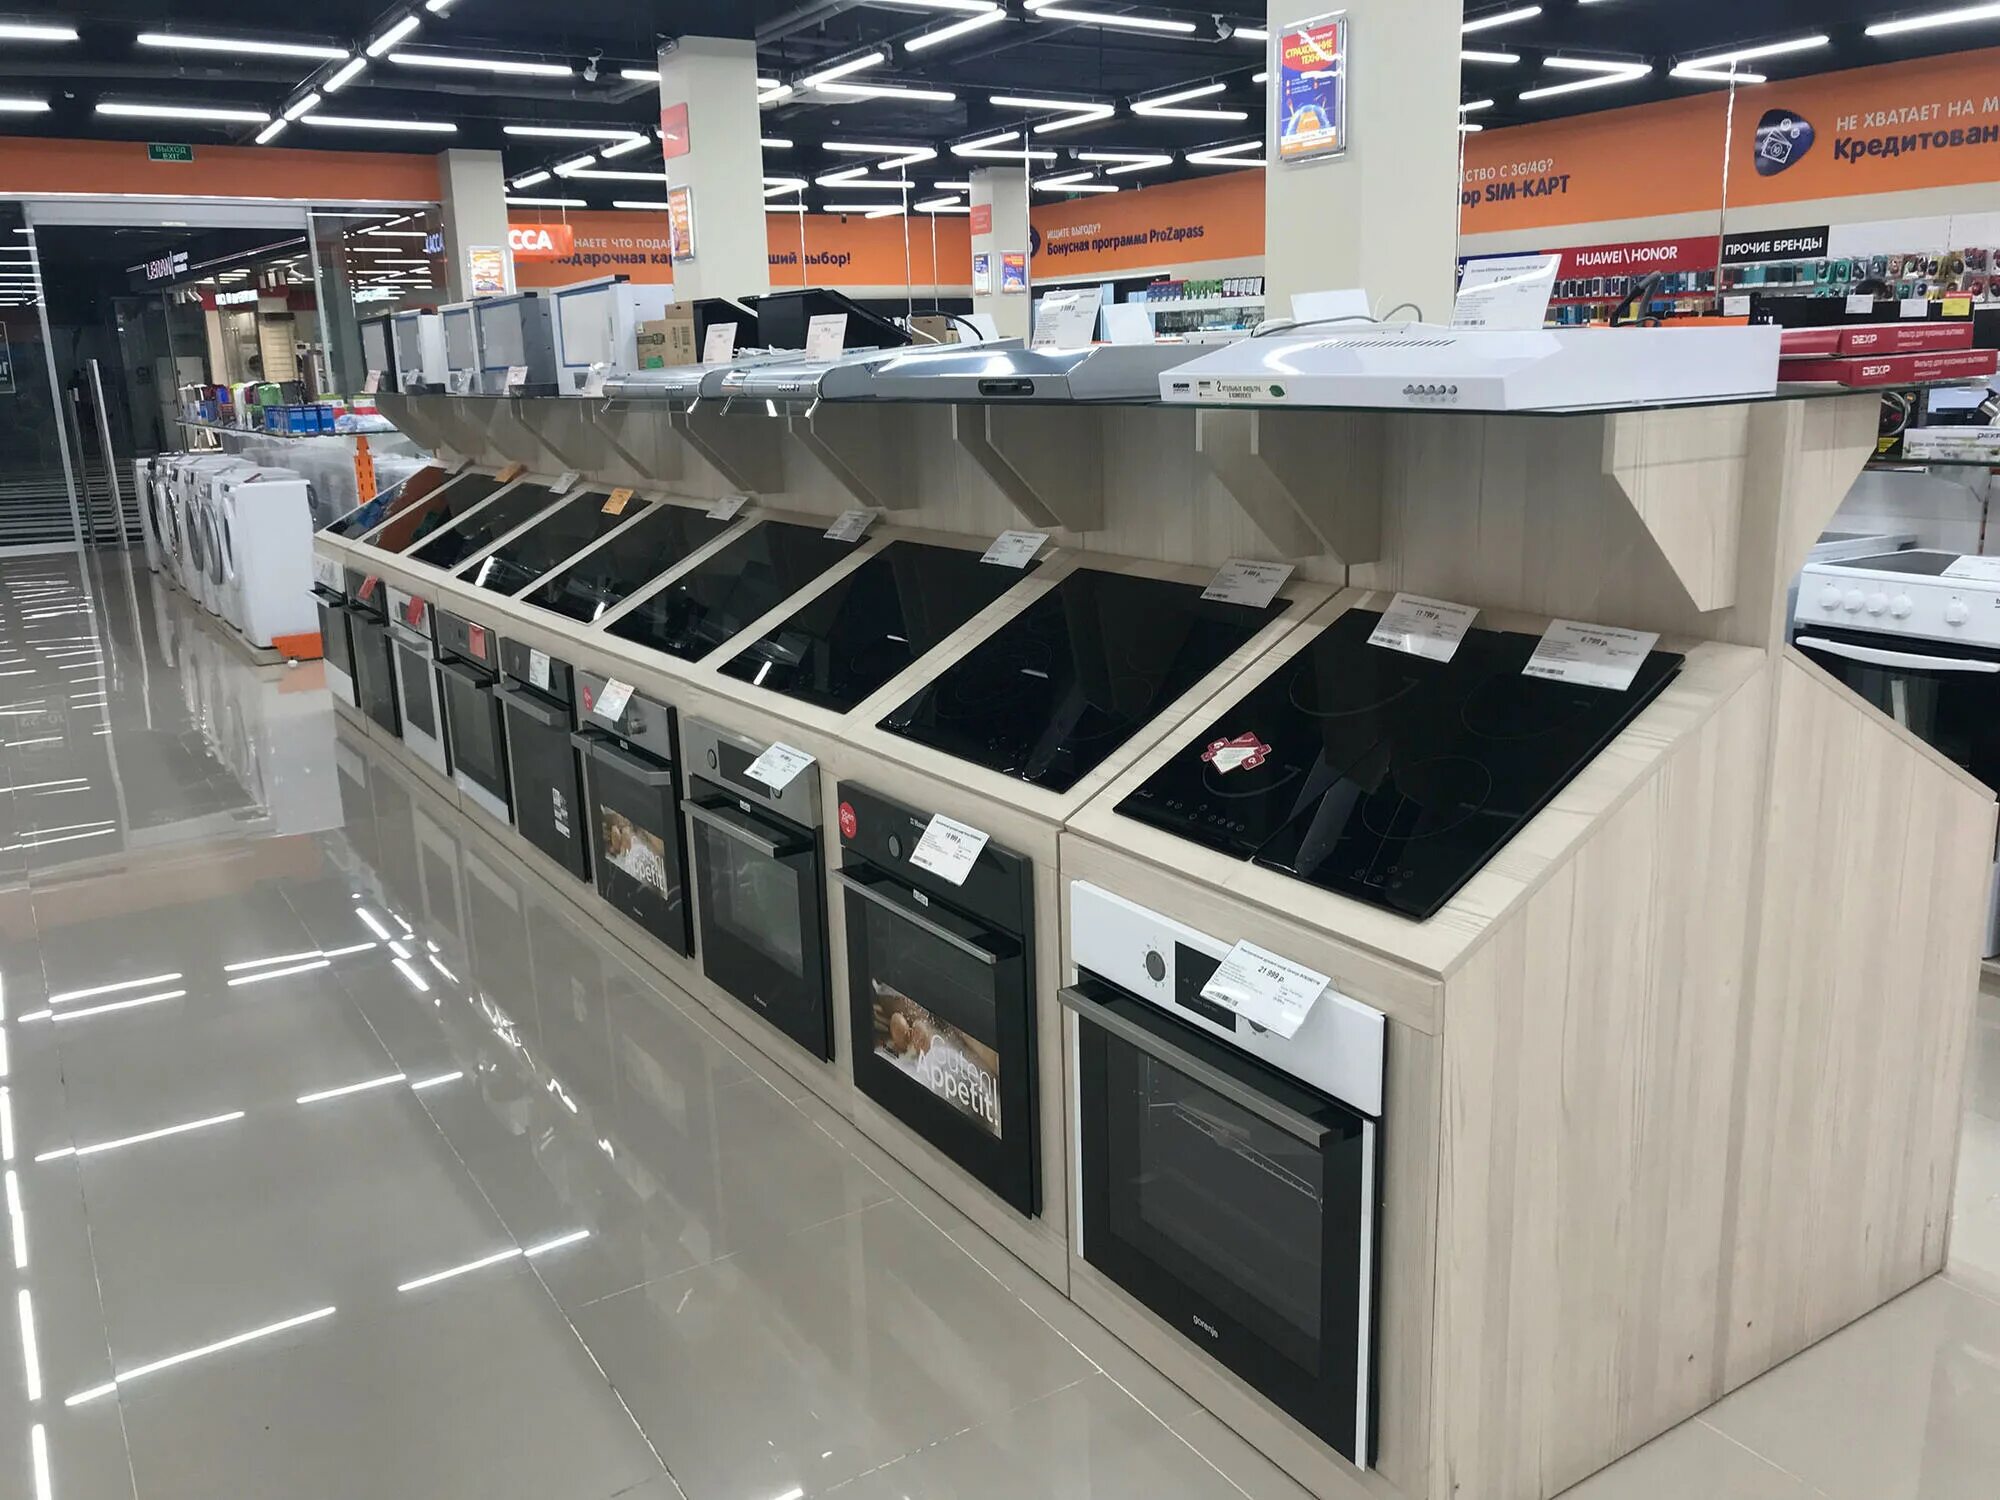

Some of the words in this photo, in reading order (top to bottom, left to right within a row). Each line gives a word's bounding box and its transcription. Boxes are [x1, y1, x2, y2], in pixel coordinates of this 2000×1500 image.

[1836, 114, 1858, 132] НЕ
[1864, 103, 1941, 129] ХВАТАЕТ
[1948, 99, 1974, 118] НА
[1511, 158, 1553, 177] 3G/4G?
[611, 238, 633, 248] ЧТО
[1047, 240, 1090, 257] Бонусная
[1091, 233, 1148, 253] программа
[1150, 224, 1205, 243] ProZapass
[1725, 242, 1771, 256] ПРОЧИЕ
[1773, 237, 1823, 252] БРЕНДЫ
[1851, 334, 1878, 345] DEXP
[1862, 364, 1891, 376] DEXP
[1216, 380, 1222, 392] 2
[1257, 965, 1266, 974] 21
[1266, 966, 1280, 980] 999
